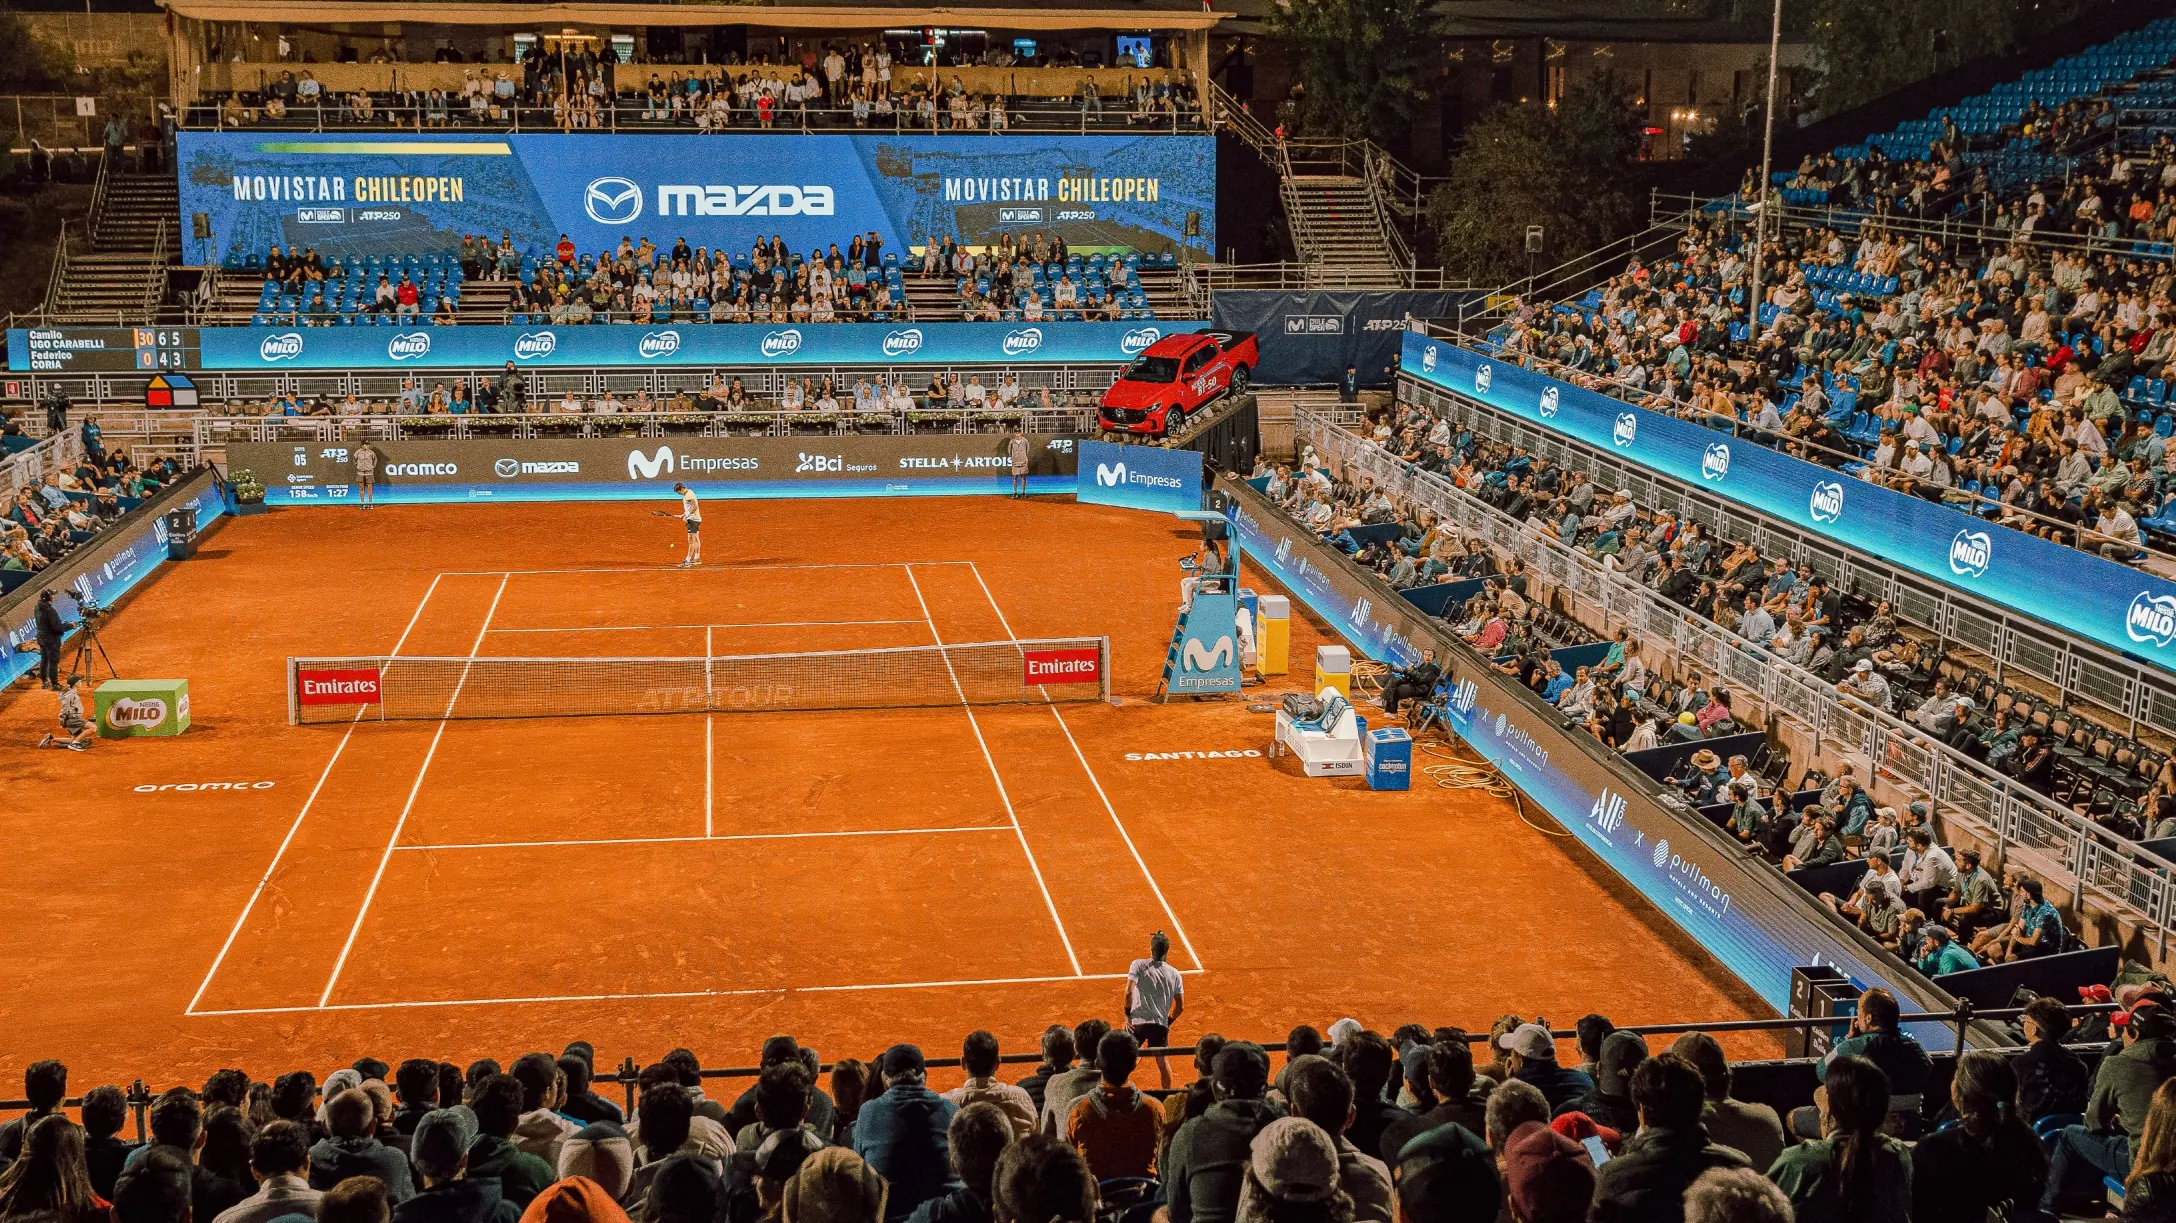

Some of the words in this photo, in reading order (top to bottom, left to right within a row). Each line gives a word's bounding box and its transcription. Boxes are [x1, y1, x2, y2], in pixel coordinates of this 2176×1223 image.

[233, 175, 345, 200] MOVISTAR
[355, 175, 464, 202] CHILEOPEN
[945, 178, 1048, 201] MOVISTAR
[1058, 177, 1158, 202] CHILEOPEN
[29, 330, 63, 340] Camilo
[139, 332, 154, 346] 30
[158, 332, 167, 346] 6
[172, 331, 180, 346] 5
[1125, 336, 1156, 346] MILO
[30, 340, 51, 349] UGO
[53, 340, 105, 349] CARABELLI
[264, 341, 299, 354] MILO
[392, 341, 426, 353] MILO
[518, 340, 551, 351] MILO
[642, 340, 675, 351] MILO
[765, 339, 797, 349] MILO
[886, 338, 918, 348] MILO
[1007, 337, 1039, 347] MILO
[31, 351, 72, 360] Federico
[143, 352, 152, 366] 0
[160, 352, 168, 366] 4
[173, 352, 181, 366] 3
[31, 361, 62, 369] CORIA
[1616, 421, 1633, 439] MILO
[1046, 440, 1073, 449] ATP
[320, 448, 348, 458] ATP
[295, 454, 306, 466] 05
[680, 455, 759, 473] Empresas
[815, 455, 842, 472] Bci
[846, 463, 877, 473] Seguros
[900, 457, 949, 468] STELLA
[1704, 453, 1726, 473] MILO
[385, 463, 457, 476] aramco
[1130, 471, 1182, 489] Empresas
[289, 490, 307, 498] 158
[327, 489, 348, 498] 1:27
[1215, 500, 1221, 508] 2
[1813, 491, 1840, 515] MILO
[173, 518, 179, 528] 2
[1953, 541, 1986, 568] MILO
[2131, 603, 2175, 637] MILO
[1392, 632, 1423, 664] pullman
[1028, 659, 1095, 675] Emirates
[304, 678, 377, 695] Emirates
[1179, 675, 1234, 690] Empresas
[115, 707, 160, 721] MILO
[1506, 724, 1548, 768] pullman
[1125, 748, 1262, 761] SANTIAGO
[134, 781, 275, 793] aramco
[1669, 873, 1686, 890] HOTELS
[1669, 854, 1730, 914] pullman
[1796, 980, 1803, 999] 2
